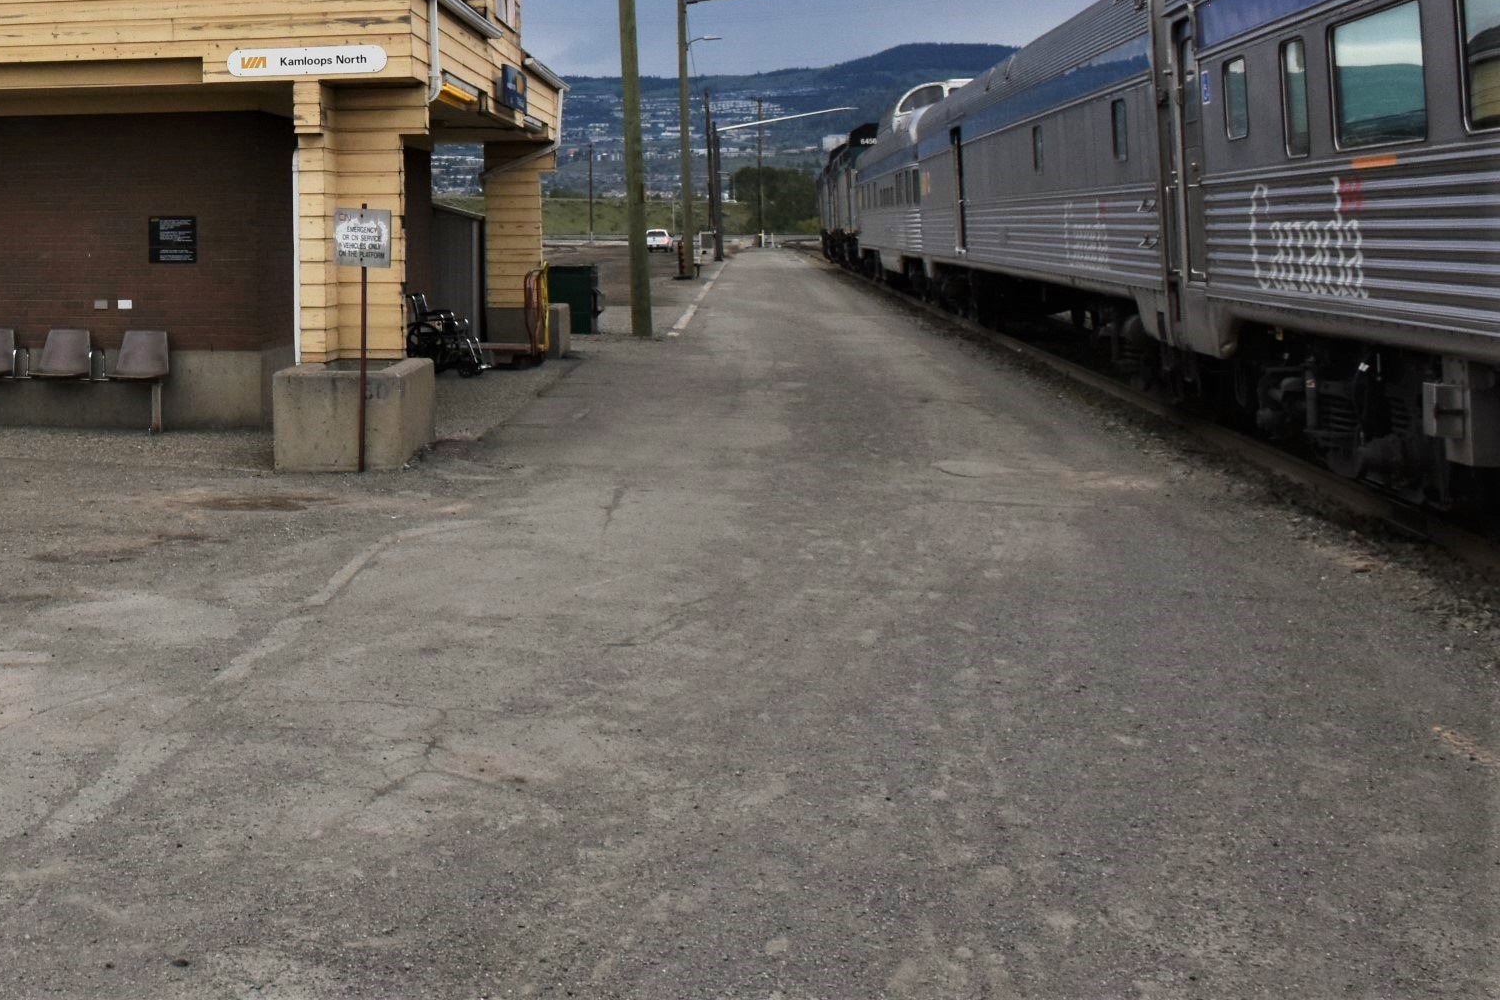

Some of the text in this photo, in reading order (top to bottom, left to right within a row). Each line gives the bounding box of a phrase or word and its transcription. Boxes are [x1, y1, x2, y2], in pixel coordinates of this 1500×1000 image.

[241, 55, 367, 69] VIA Kamloops North
[1250, 176, 1368, 298] Canada
